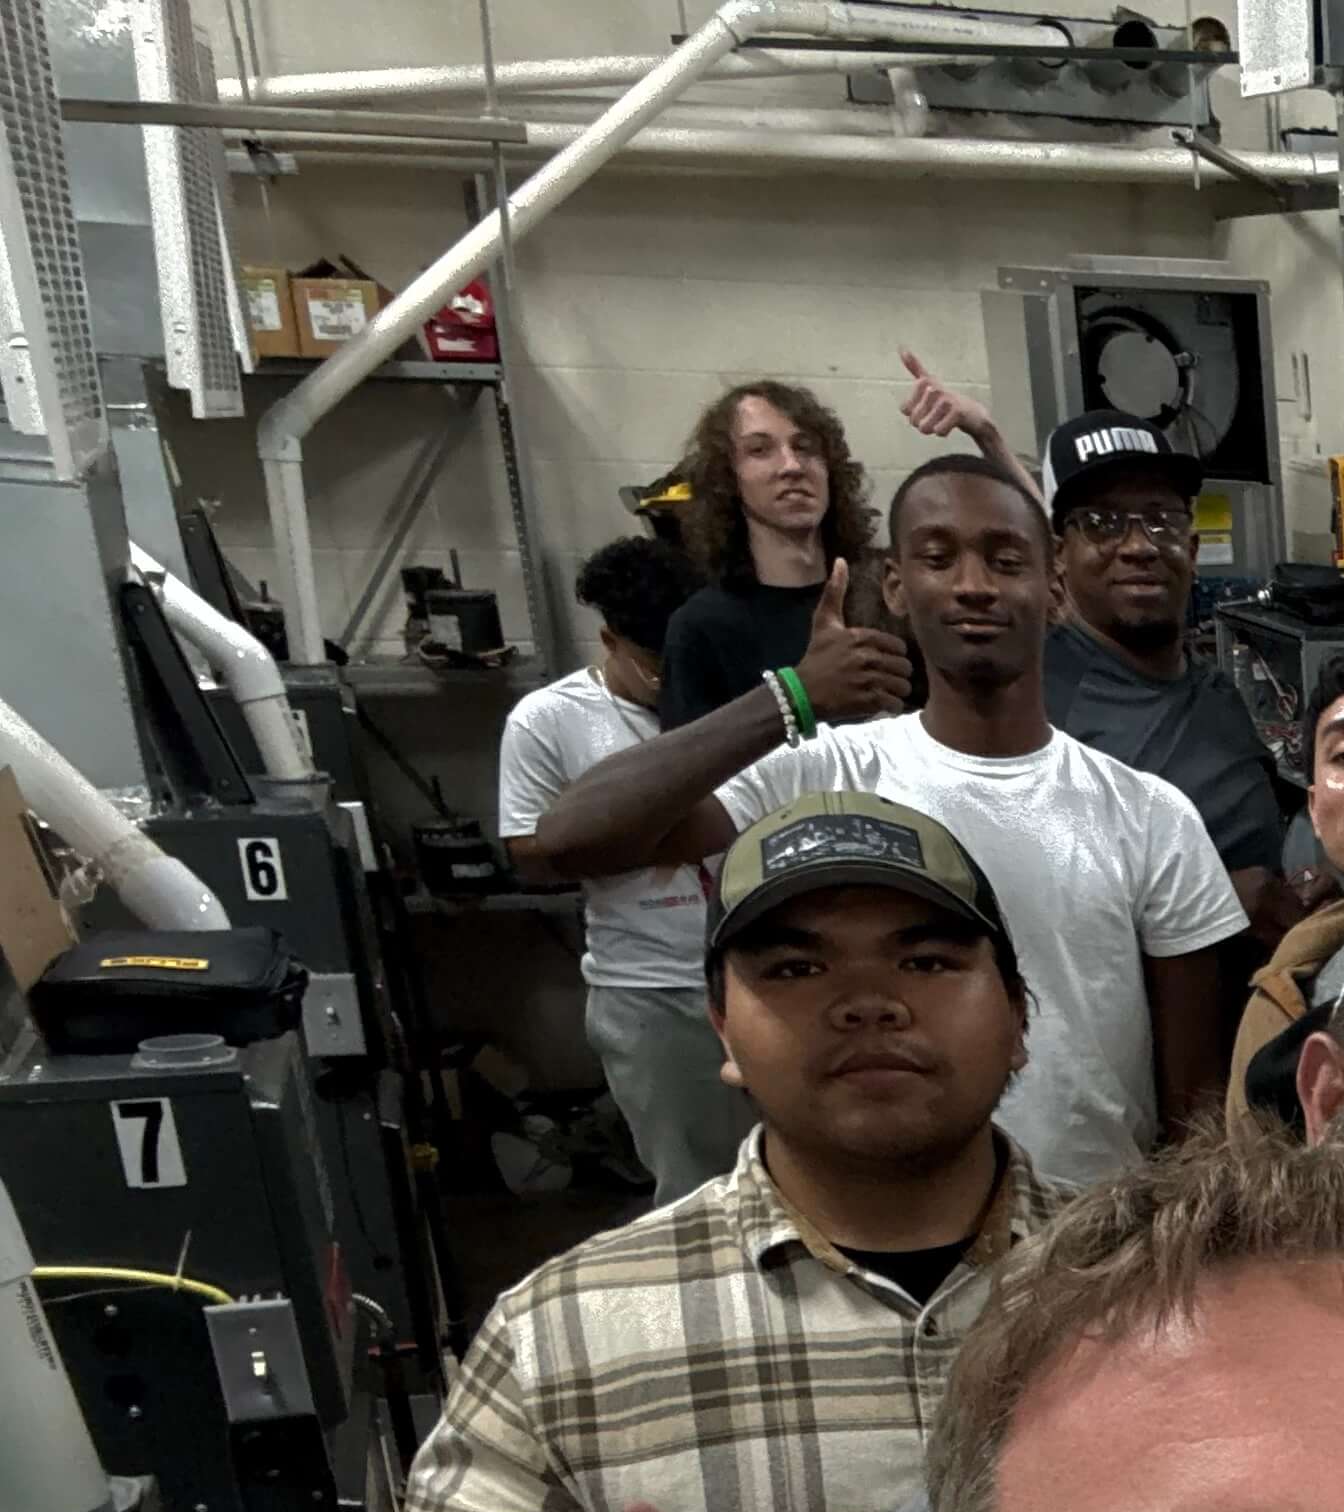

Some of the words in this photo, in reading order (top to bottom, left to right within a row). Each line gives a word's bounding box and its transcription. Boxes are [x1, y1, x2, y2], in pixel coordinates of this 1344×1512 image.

[1075, 427, 1158, 462] PUMA
[245, 841, 278, 896] 6
[117, 1101, 164, 1183] 7
